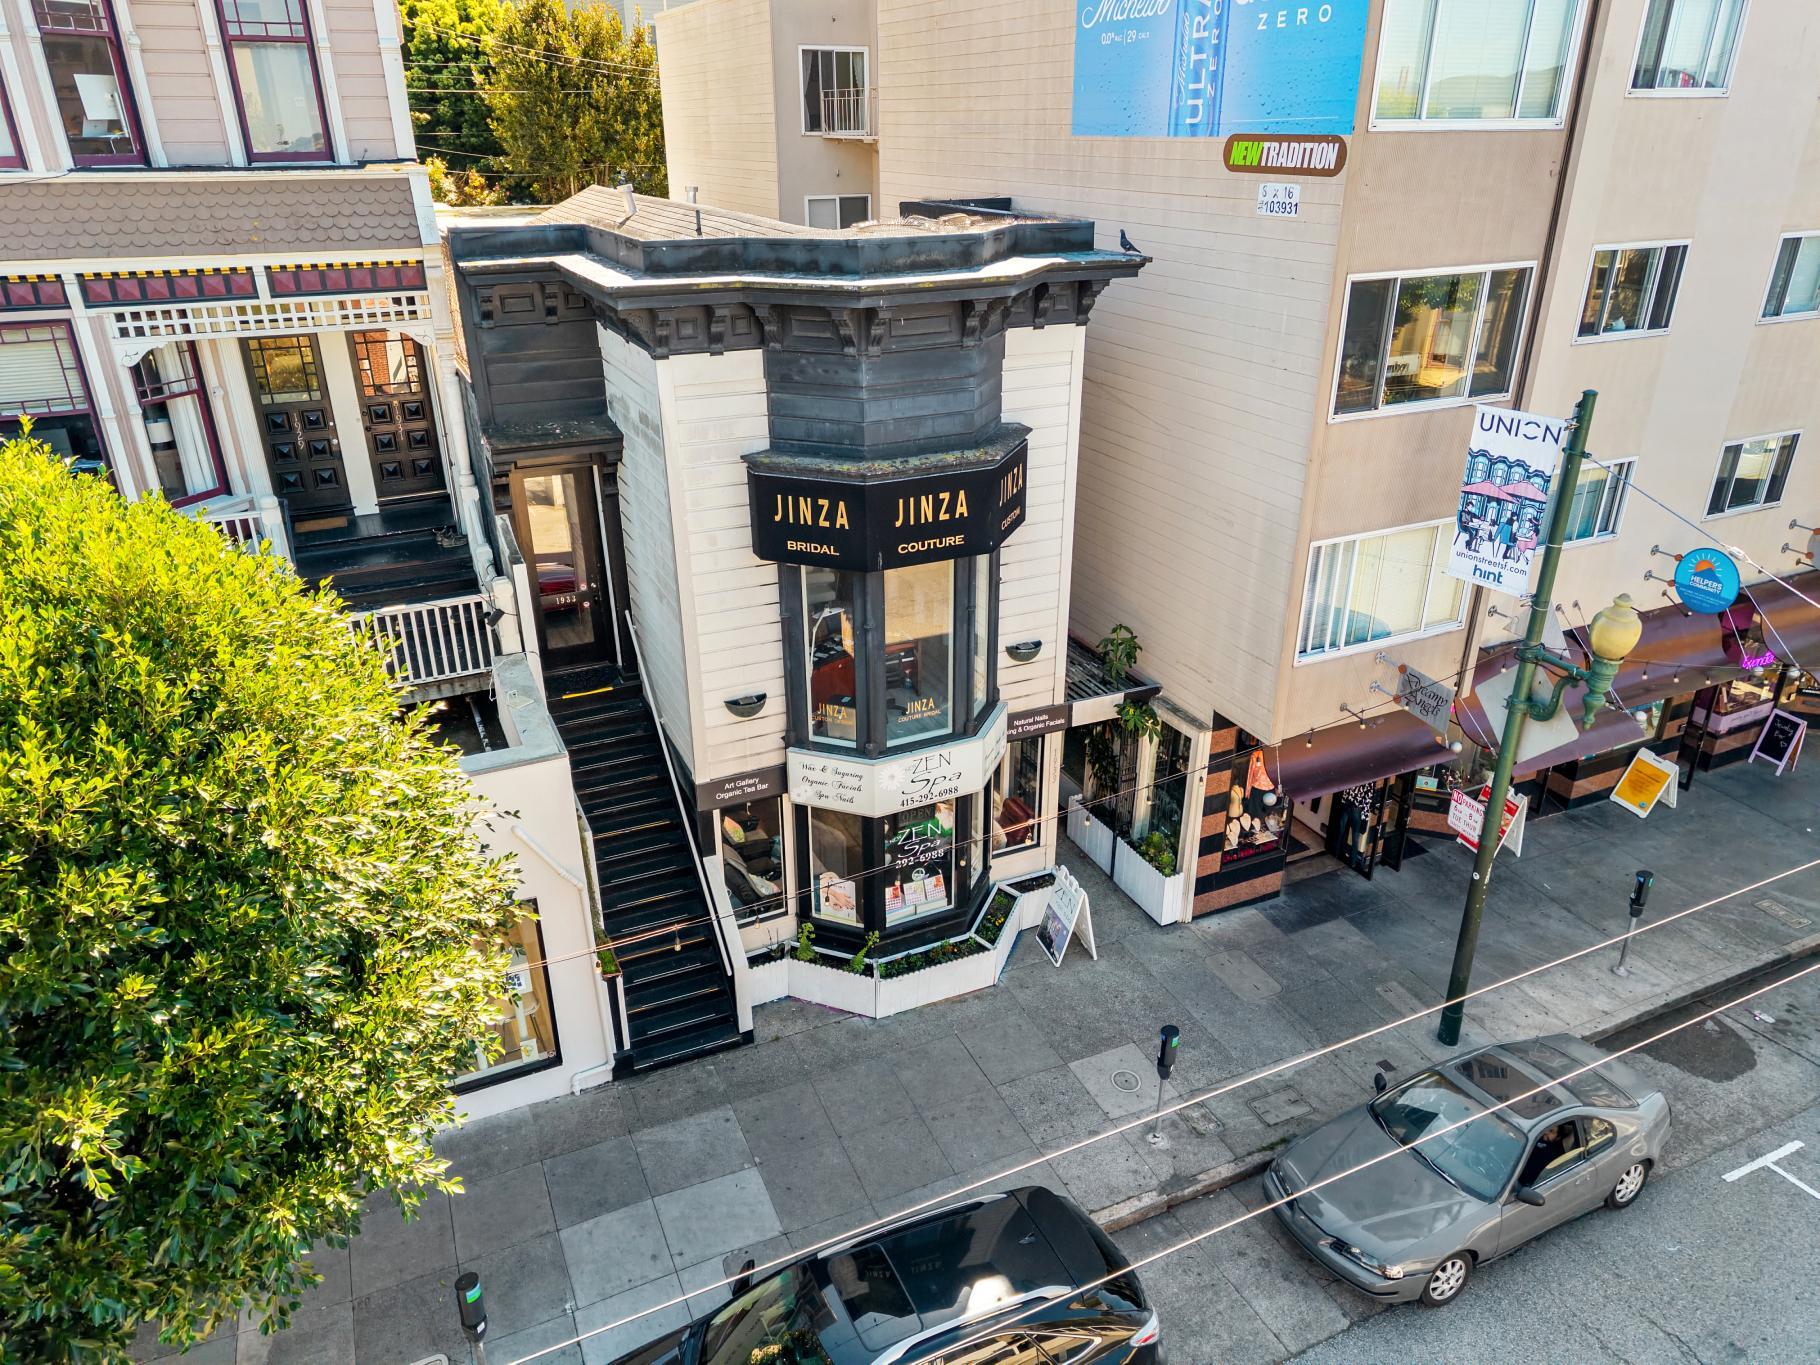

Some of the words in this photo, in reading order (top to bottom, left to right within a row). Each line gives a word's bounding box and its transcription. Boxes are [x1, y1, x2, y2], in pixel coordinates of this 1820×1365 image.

[1257, 4, 1332, 30] ZERO
[1127, 29, 1137, 42] 29
[1184, 0, 1212, 124] ULTR
[294, 412, 305, 450] 1929
[1480, 412, 1563, 446] UNION
[999, 462, 1023, 508] JINZA
[774, 494, 849, 530] JINZA
[895, 489, 968, 528] JINZA
[787, 540, 840, 556] BRIDAL
[898, 534, 965, 554] COUTURE
[1456, 550, 1527, 577] unionstreetsf.com
[1473, 564, 1503, 584] hint
[1690, 575, 1723, 591] HELPERS
[555, 595, 577, 605] 1933
[1406, 672, 1448, 708] Dreamy
[817, 702, 848, 719] JINZA
[906, 697, 935, 715] JINZA
[1404, 690, 1441, 717] Angels
[1013, 716, 1034, 727] Natural
[1035, 714, 1049, 723] Nails
[1023, 721, 1045, 733] Organic
[1046, 717, 1065, 727] Facials
[820, 765, 830, 774] &
[832, 766, 864, 781] Sugaring
[912, 752, 951, 774] ZEN
[715, 788, 742, 800] Organic
[744, 785, 756, 794] Tea
[757, 783, 769, 791] Bar
[724, 782, 735, 790] Art
[736, 777, 760, 788] Gallery
[801, 775, 829, 788] Organic
[901, 771, 962, 795] Spa
[900, 785, 959, 808] 415-292-6988
[1453, 790, 1463, 805] NO
[1462, 799, 1484, 817] PARKING
[897, 823, 942, 845] ZEN
[895, 848, 944, 869] 292-6988
[897, 839, 941, 858] Spa
